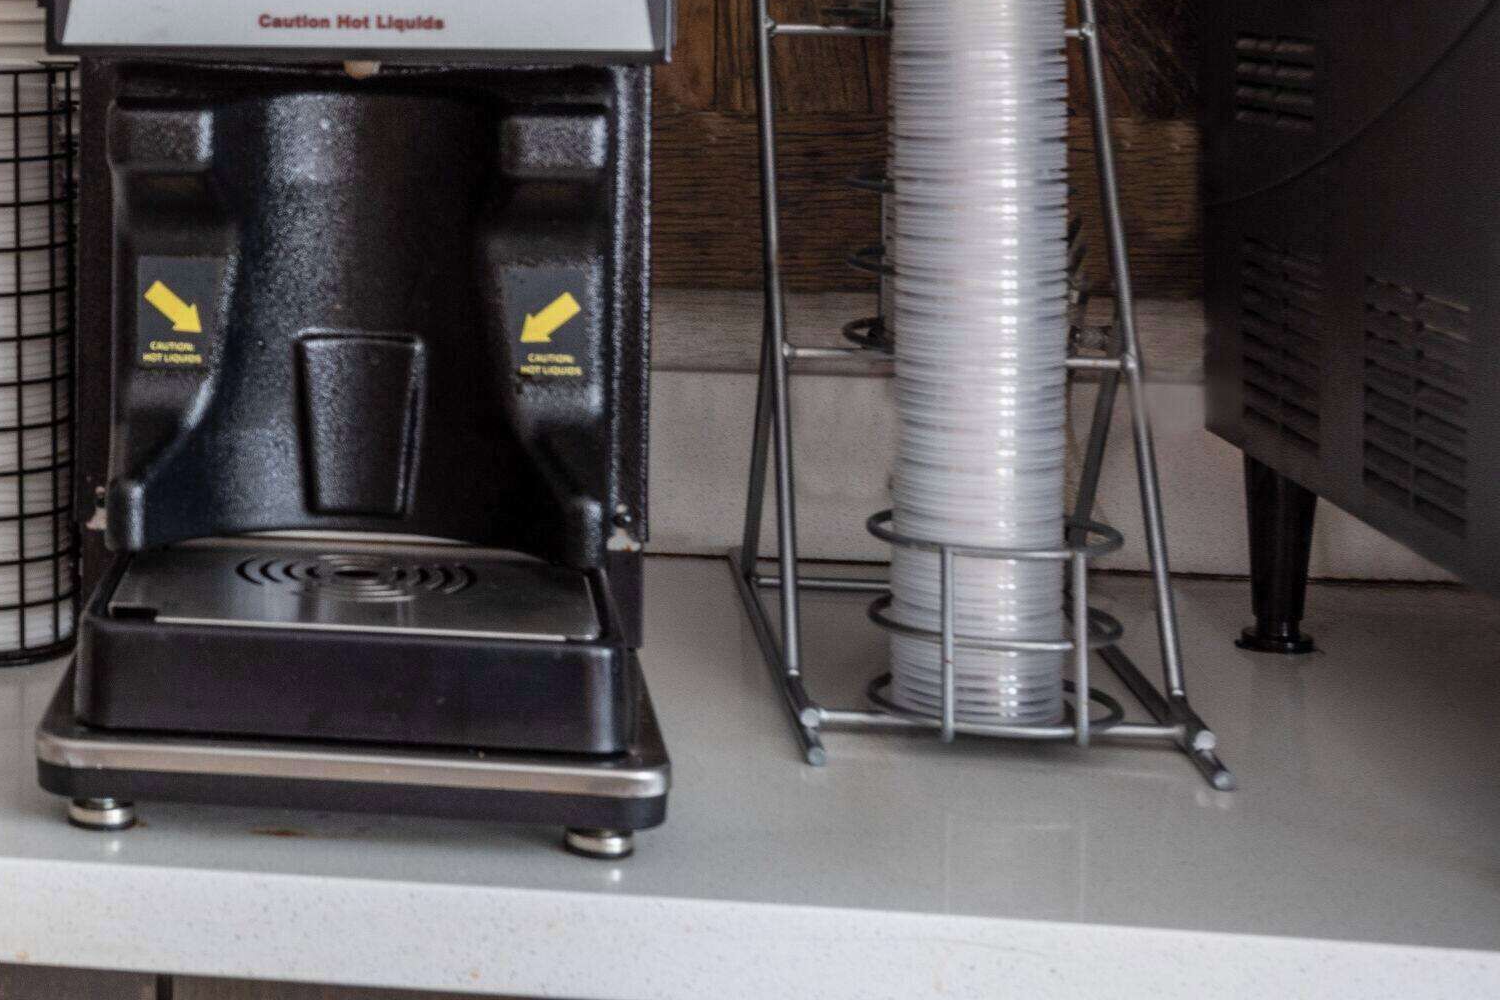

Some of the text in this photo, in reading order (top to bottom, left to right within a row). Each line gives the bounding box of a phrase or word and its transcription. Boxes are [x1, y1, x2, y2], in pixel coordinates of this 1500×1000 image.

[258, 13, 445, 33] Caution Hot Liquids
[142, 352, 202, 365] HOT LIQUIDS
[519, 365, 583, 377] HOT LIQUIDS
